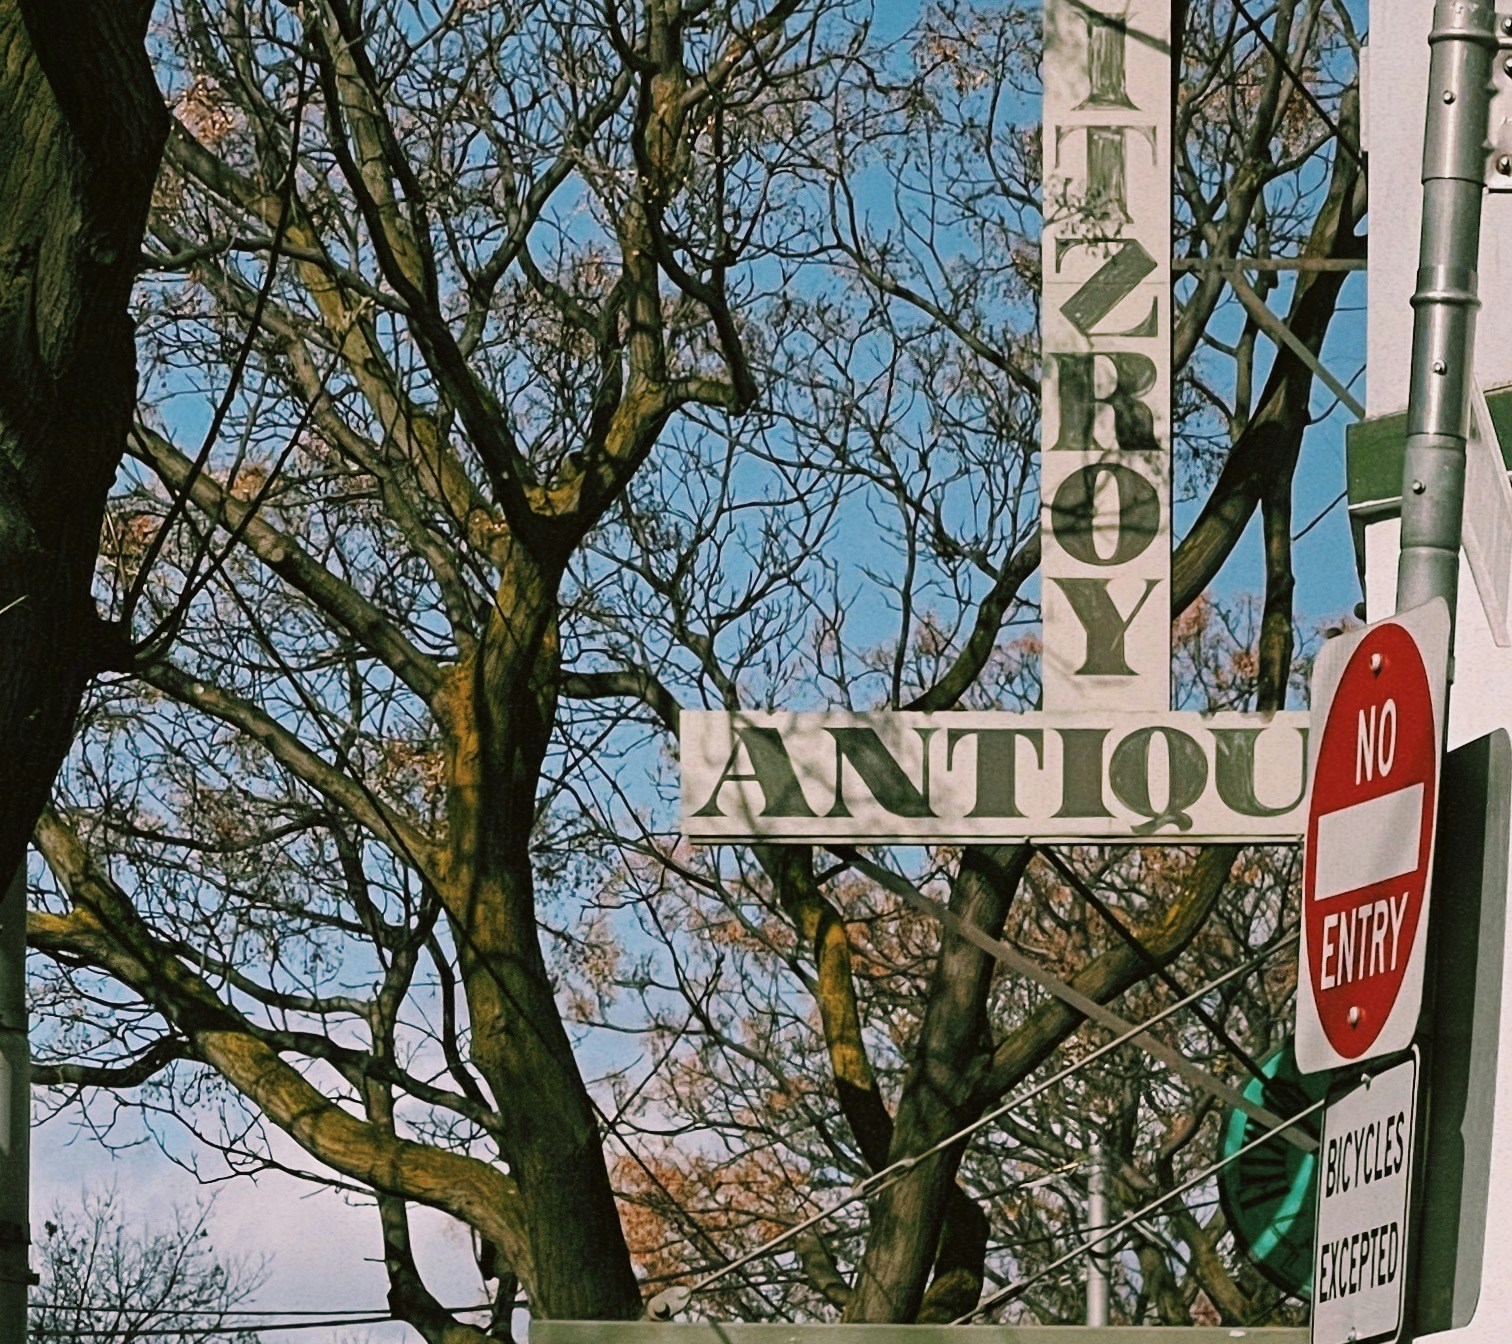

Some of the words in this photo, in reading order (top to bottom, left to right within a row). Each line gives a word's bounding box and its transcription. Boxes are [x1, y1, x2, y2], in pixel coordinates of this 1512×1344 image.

[1355, 698, 1398, 786] NO
[1320, 891, 1410, 991] ENTRY
[1325, 1110, 1405, 1199] BICYCLES
[1319, 1221, 1399, 1304] EXCEPTED
